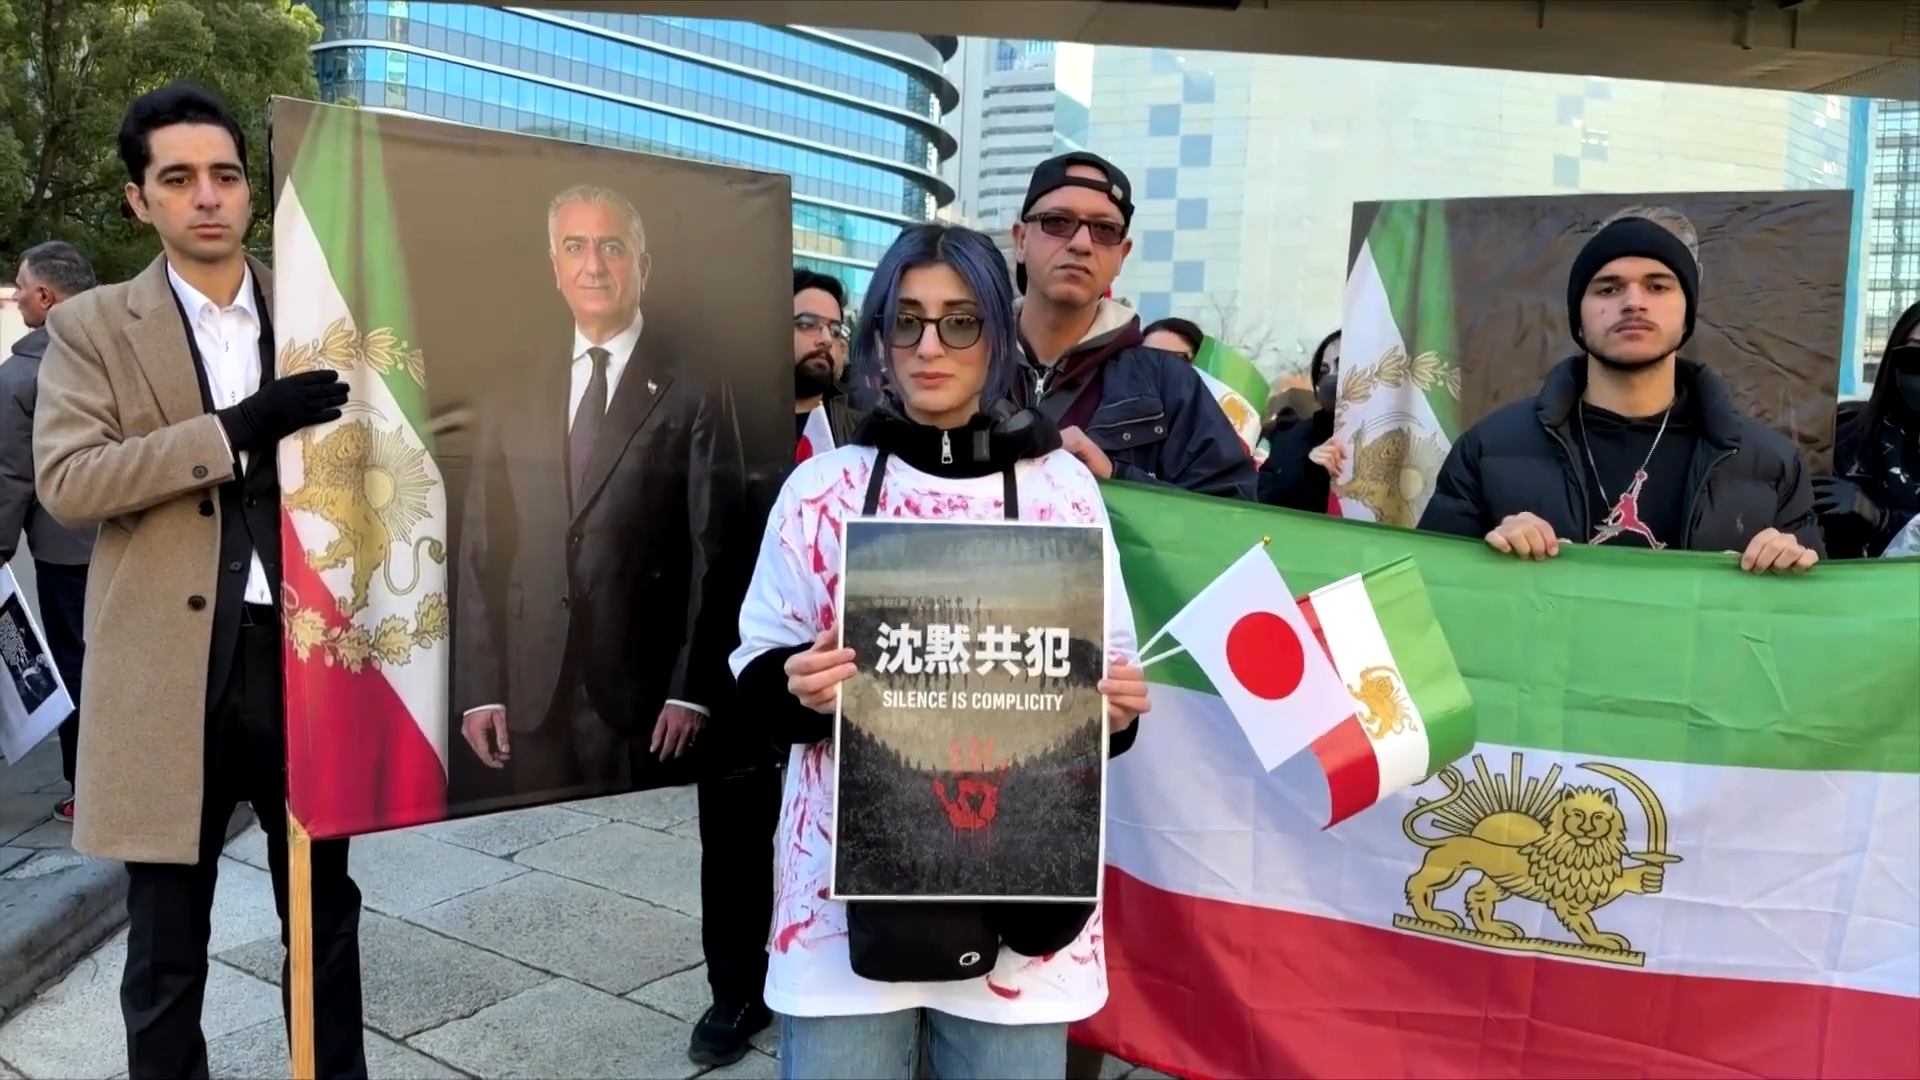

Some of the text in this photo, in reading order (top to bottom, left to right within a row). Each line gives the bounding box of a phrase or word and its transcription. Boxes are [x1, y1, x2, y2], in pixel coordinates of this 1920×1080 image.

[875, 622, 1071, 677] 沈黙共犯
[882, 690, 1063, 711] SILENCE IS COMPLICITY
